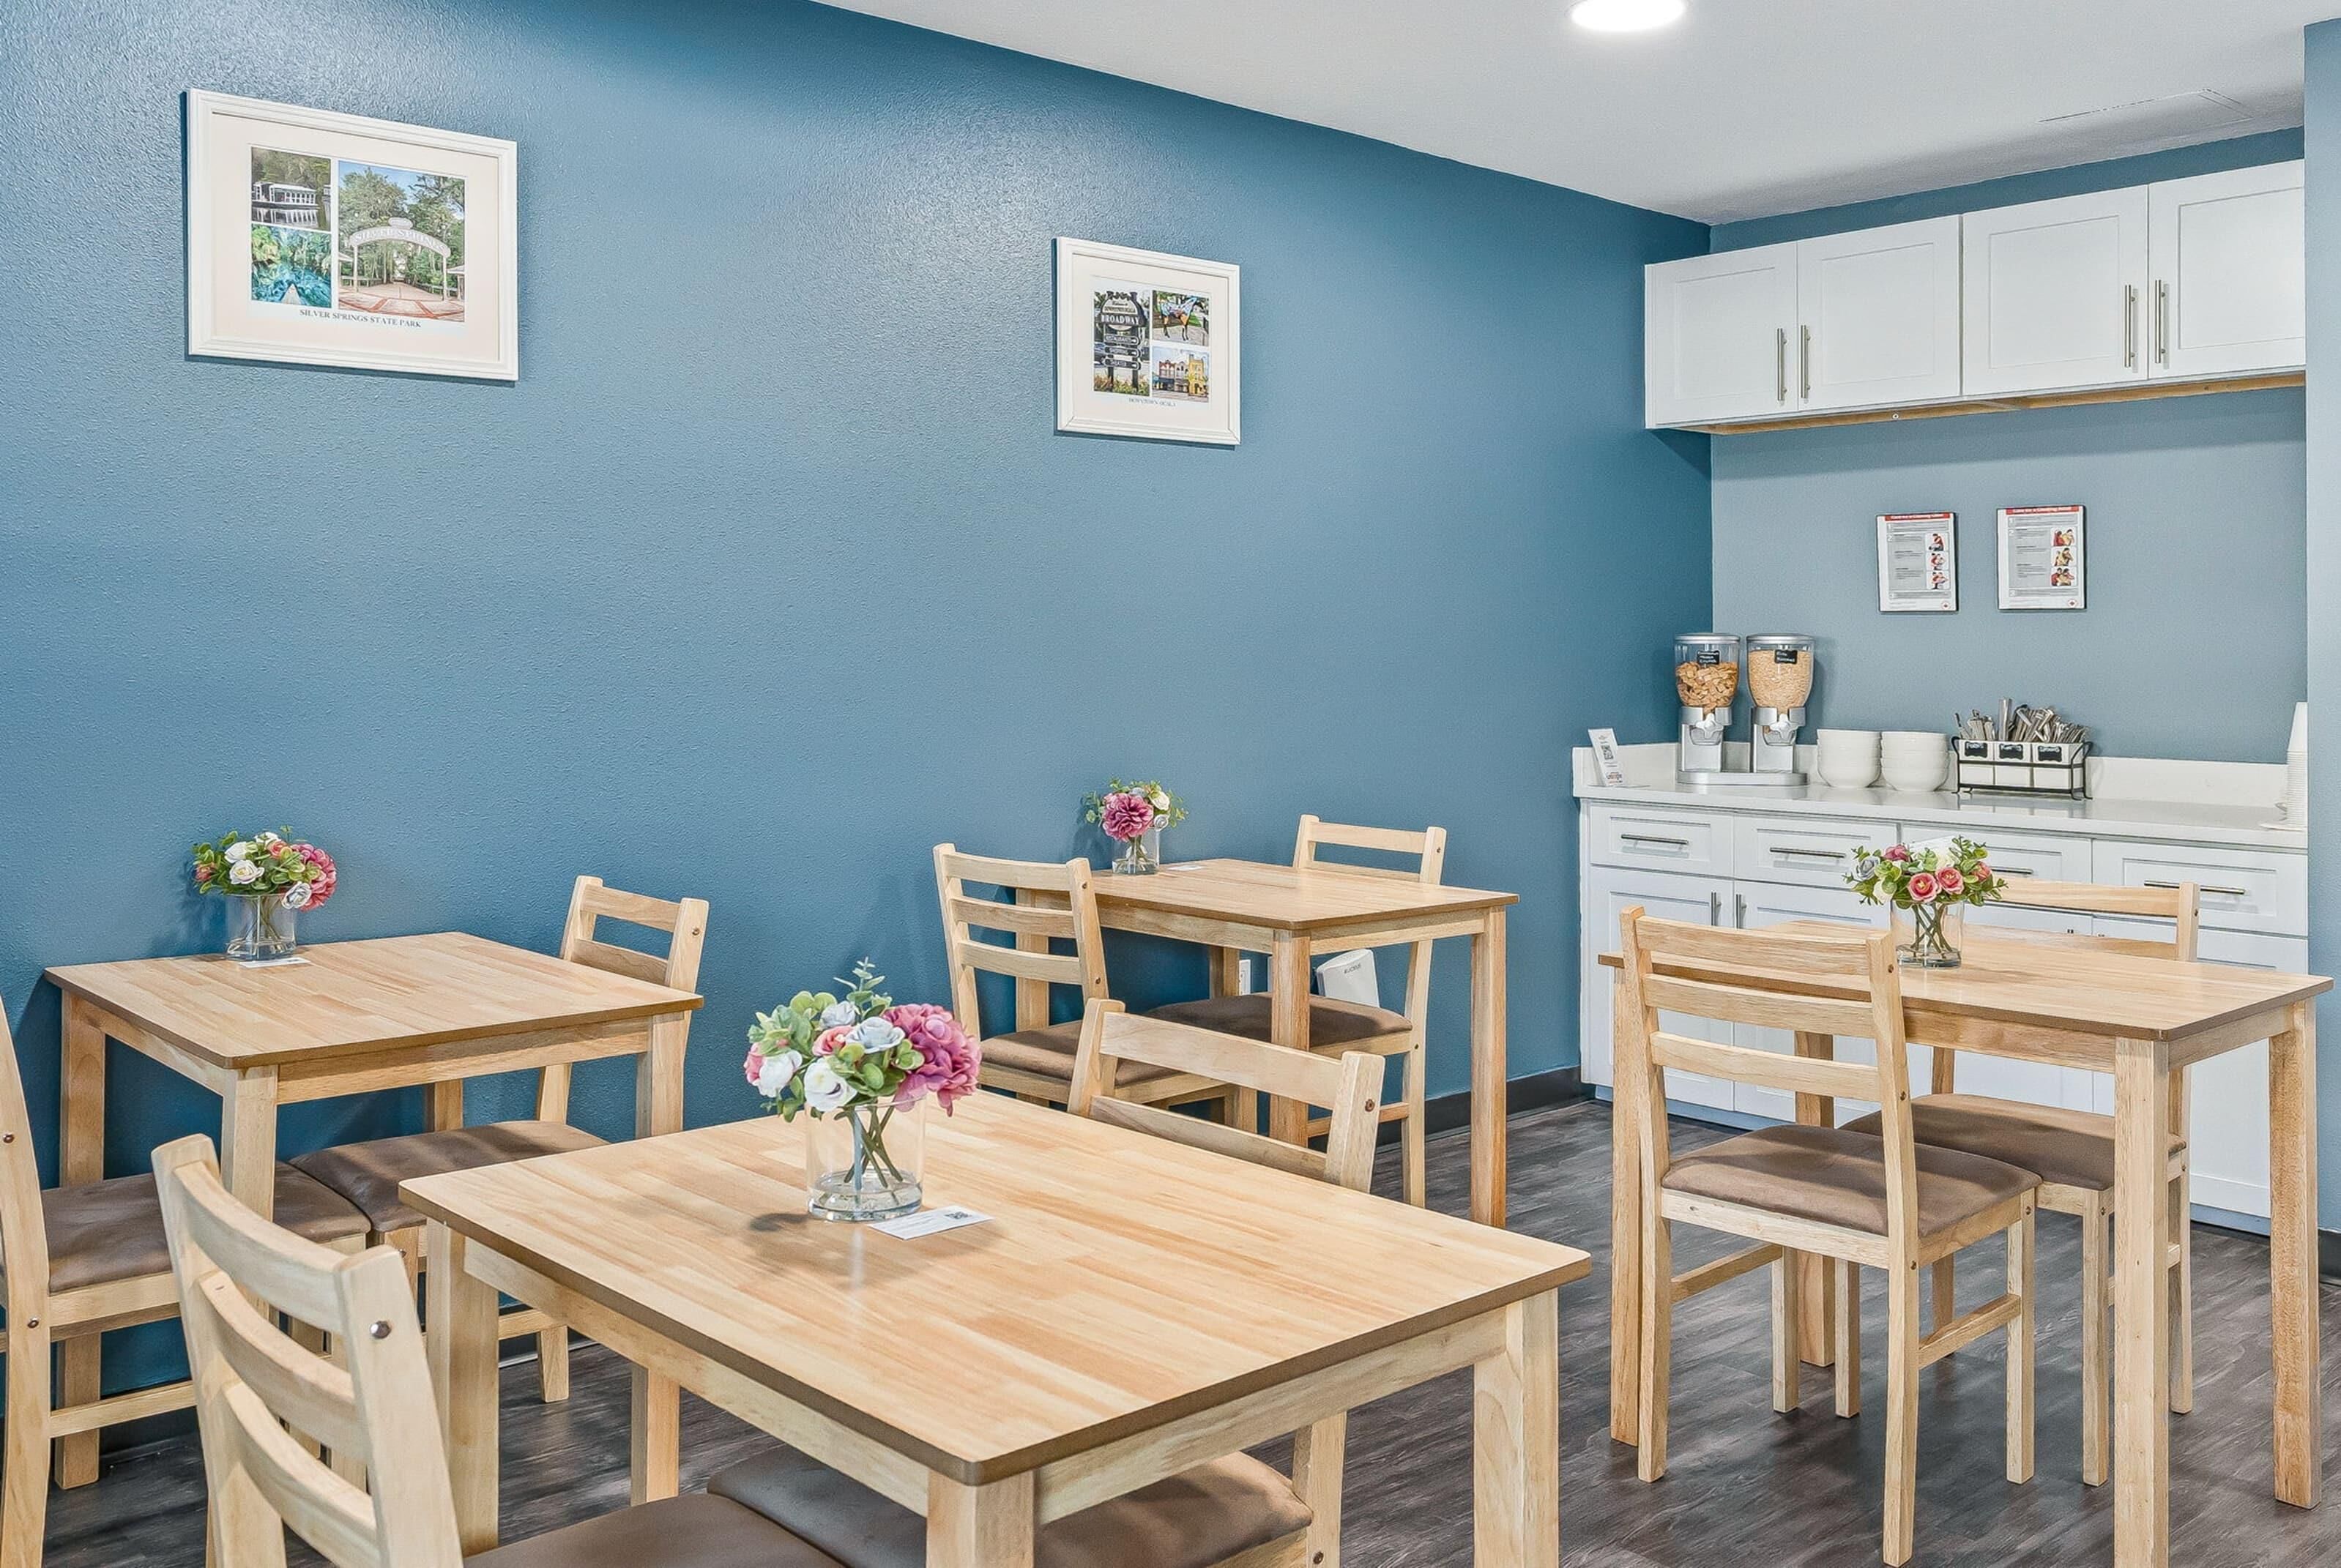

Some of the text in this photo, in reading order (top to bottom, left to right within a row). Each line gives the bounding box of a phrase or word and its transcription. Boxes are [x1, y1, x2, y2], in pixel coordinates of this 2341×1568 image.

[299, 309, 422, 328] SILVER SPRINGS STATE PARK
[1101, 314, 1139, 325] BROADWAY
